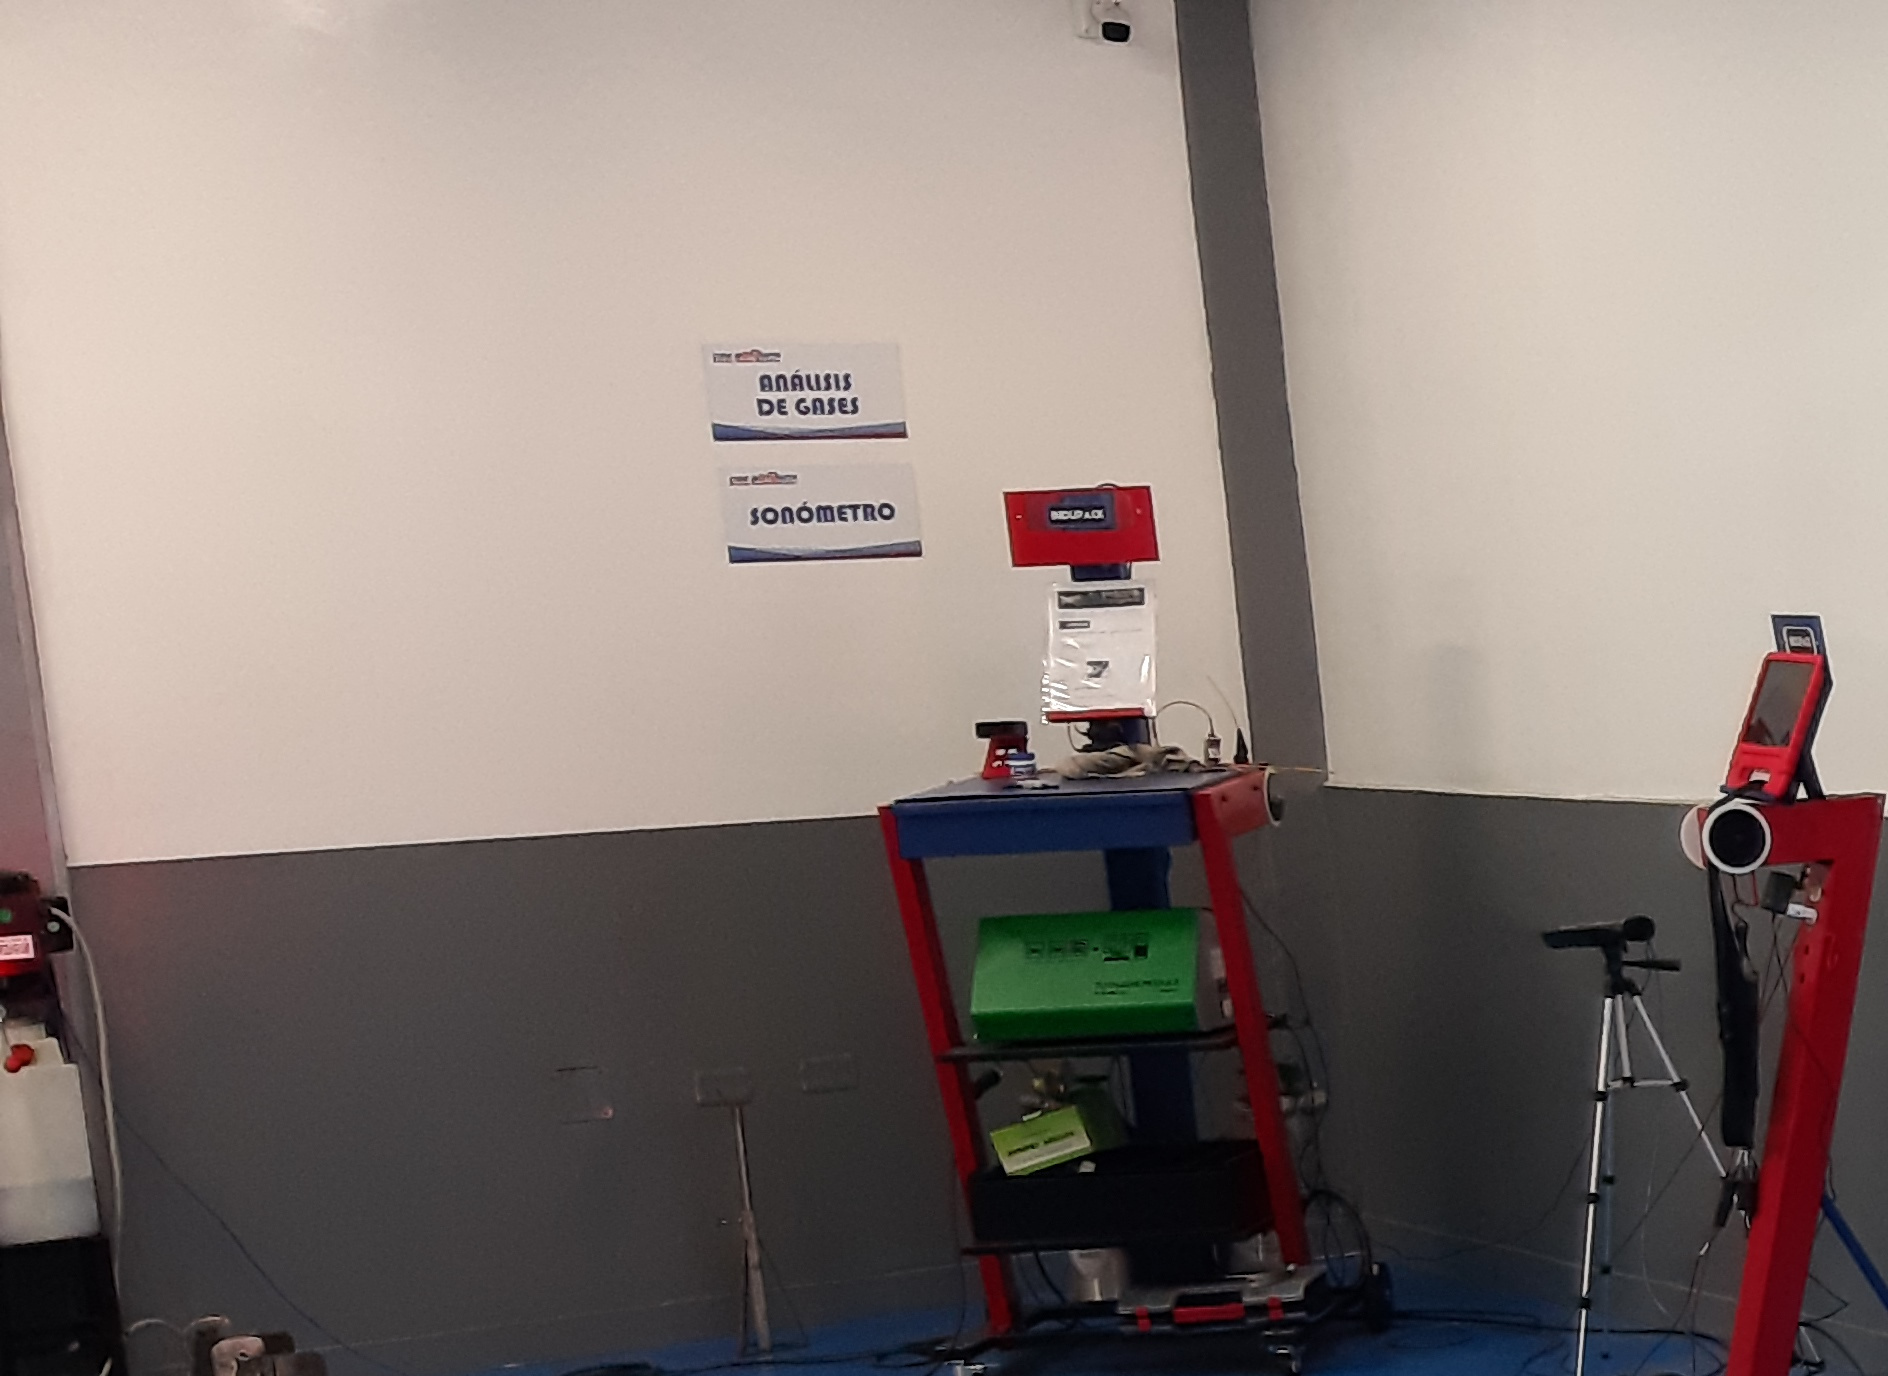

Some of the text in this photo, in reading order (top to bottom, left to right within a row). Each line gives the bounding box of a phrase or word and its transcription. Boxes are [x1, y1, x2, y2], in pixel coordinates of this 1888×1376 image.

[758, 369, 852, 392] ANÁLISIS
[756, 396, 860, 416] DE GASES
[749, 501, 896, 526] SONÓMETRO
